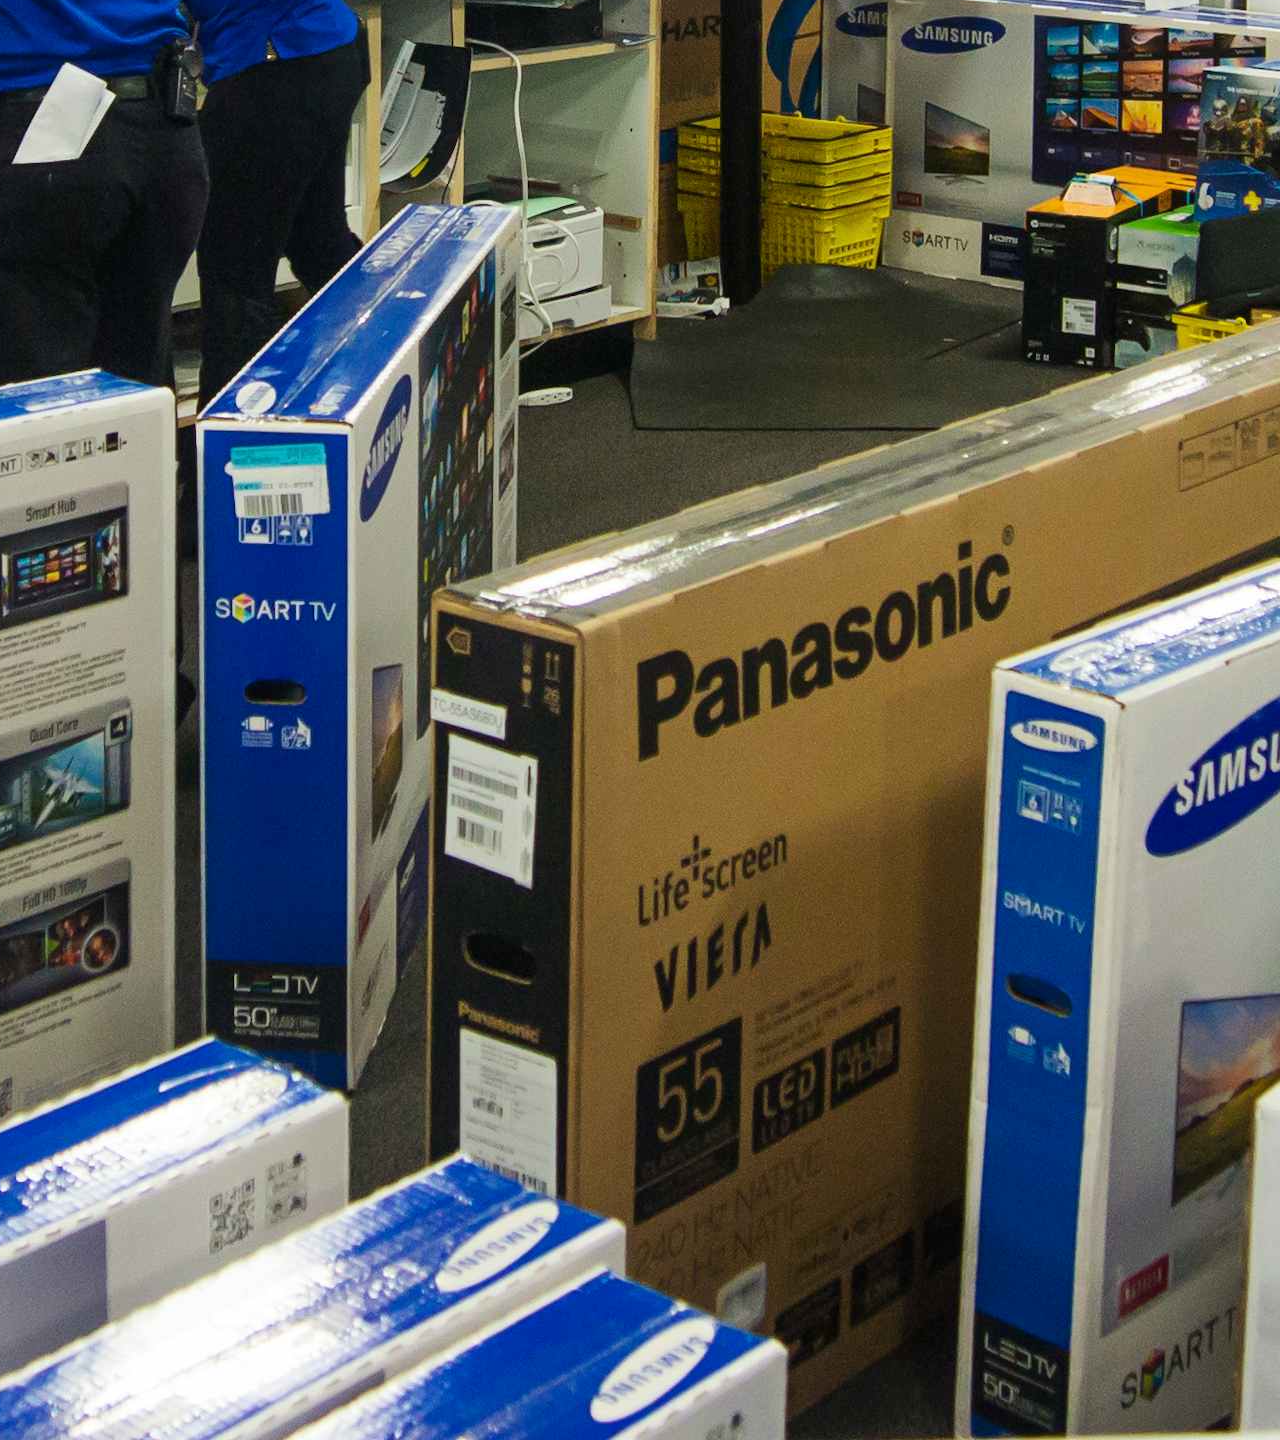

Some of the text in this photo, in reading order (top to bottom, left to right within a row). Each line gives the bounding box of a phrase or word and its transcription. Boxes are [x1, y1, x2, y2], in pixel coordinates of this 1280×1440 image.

[914, 24, 994, 47] SAMSUNG
[903, 231, 968, 252] SMART TV
[989, 233, 1019, 244] HDMI
[25, 497, 76, 523] Smart Hub
[215, 593, 336, 623] SMART TV
[637, 539, 1011, 762] Panasonic
[29, 716, 80, 744] Quad Core
[1022, 723, 1087, 750] SAMSUNG
[23, 877, 89, 913] Full HD 1080p
[1003, 891, 1086, 934] SMART TV
[653, 901, 773, 1013] VIERA
[291, 975, 318, 994] TV
[234, 1005, 277, 1028] 50"
[458, 1000, 542, 1043] Panasonic
[656, 1037, 723, 1144] 55
[762, 1059, 816, 1118] LED
[984, 1331, 1057, 1379] LED TV
